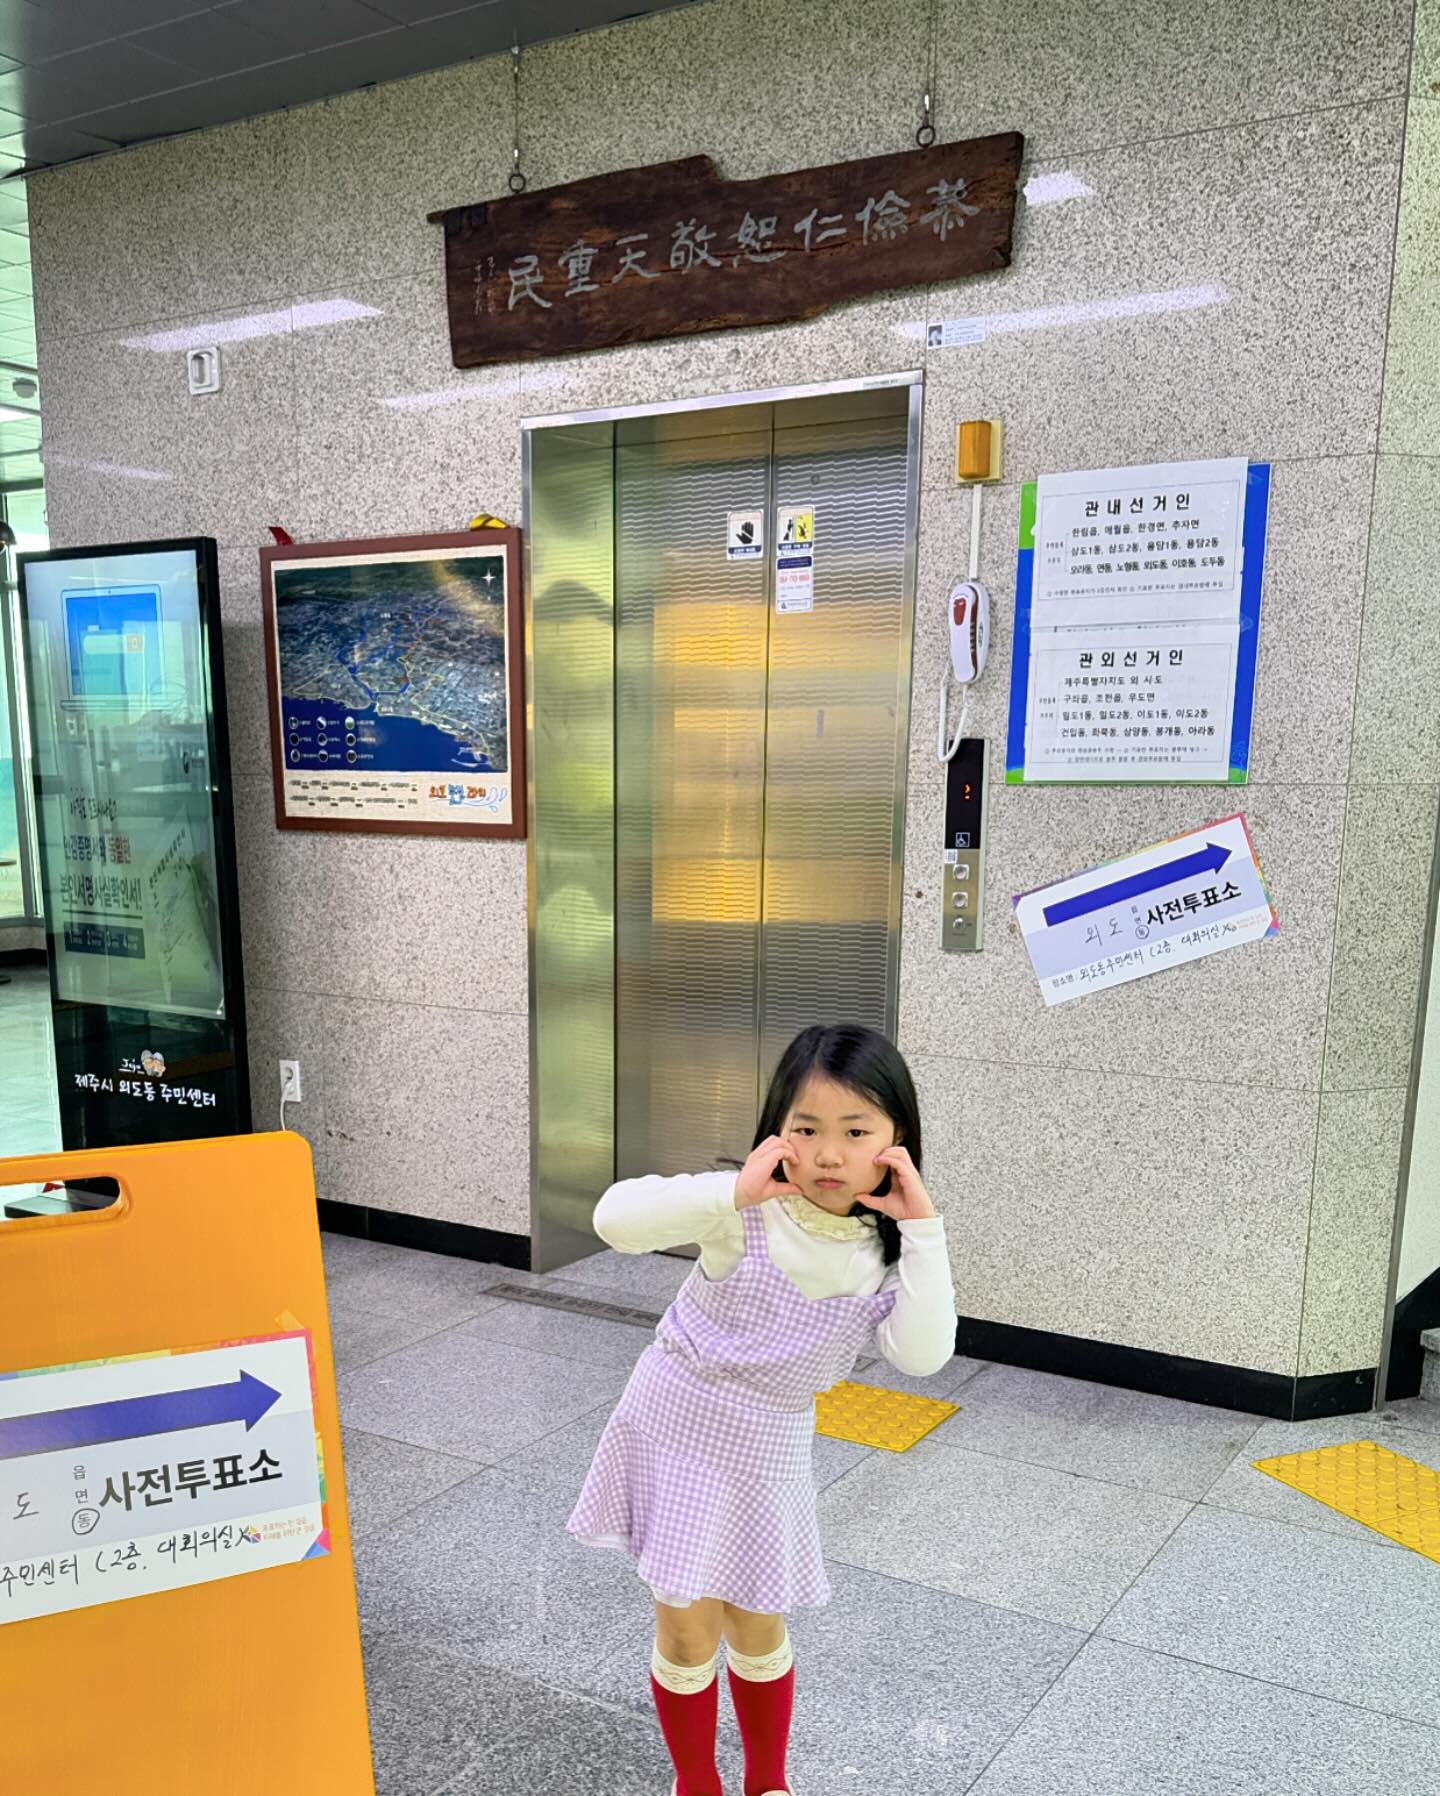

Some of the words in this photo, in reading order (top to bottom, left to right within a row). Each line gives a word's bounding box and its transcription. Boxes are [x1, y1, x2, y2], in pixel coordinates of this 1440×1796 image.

[1085, 493, 1190, 517] 관내선거인
[1079, 649, 1183, 669] 관외선거인
[1146, 881, 1242, 925] 사전투표소
[74, 1073, 114, 1093] 제주시
[119, 1080, 157, 1102] 외도동
[159, 1084, 216, 1108] 주민센터
[98, 1448, 283, 1511] 사전투표소
